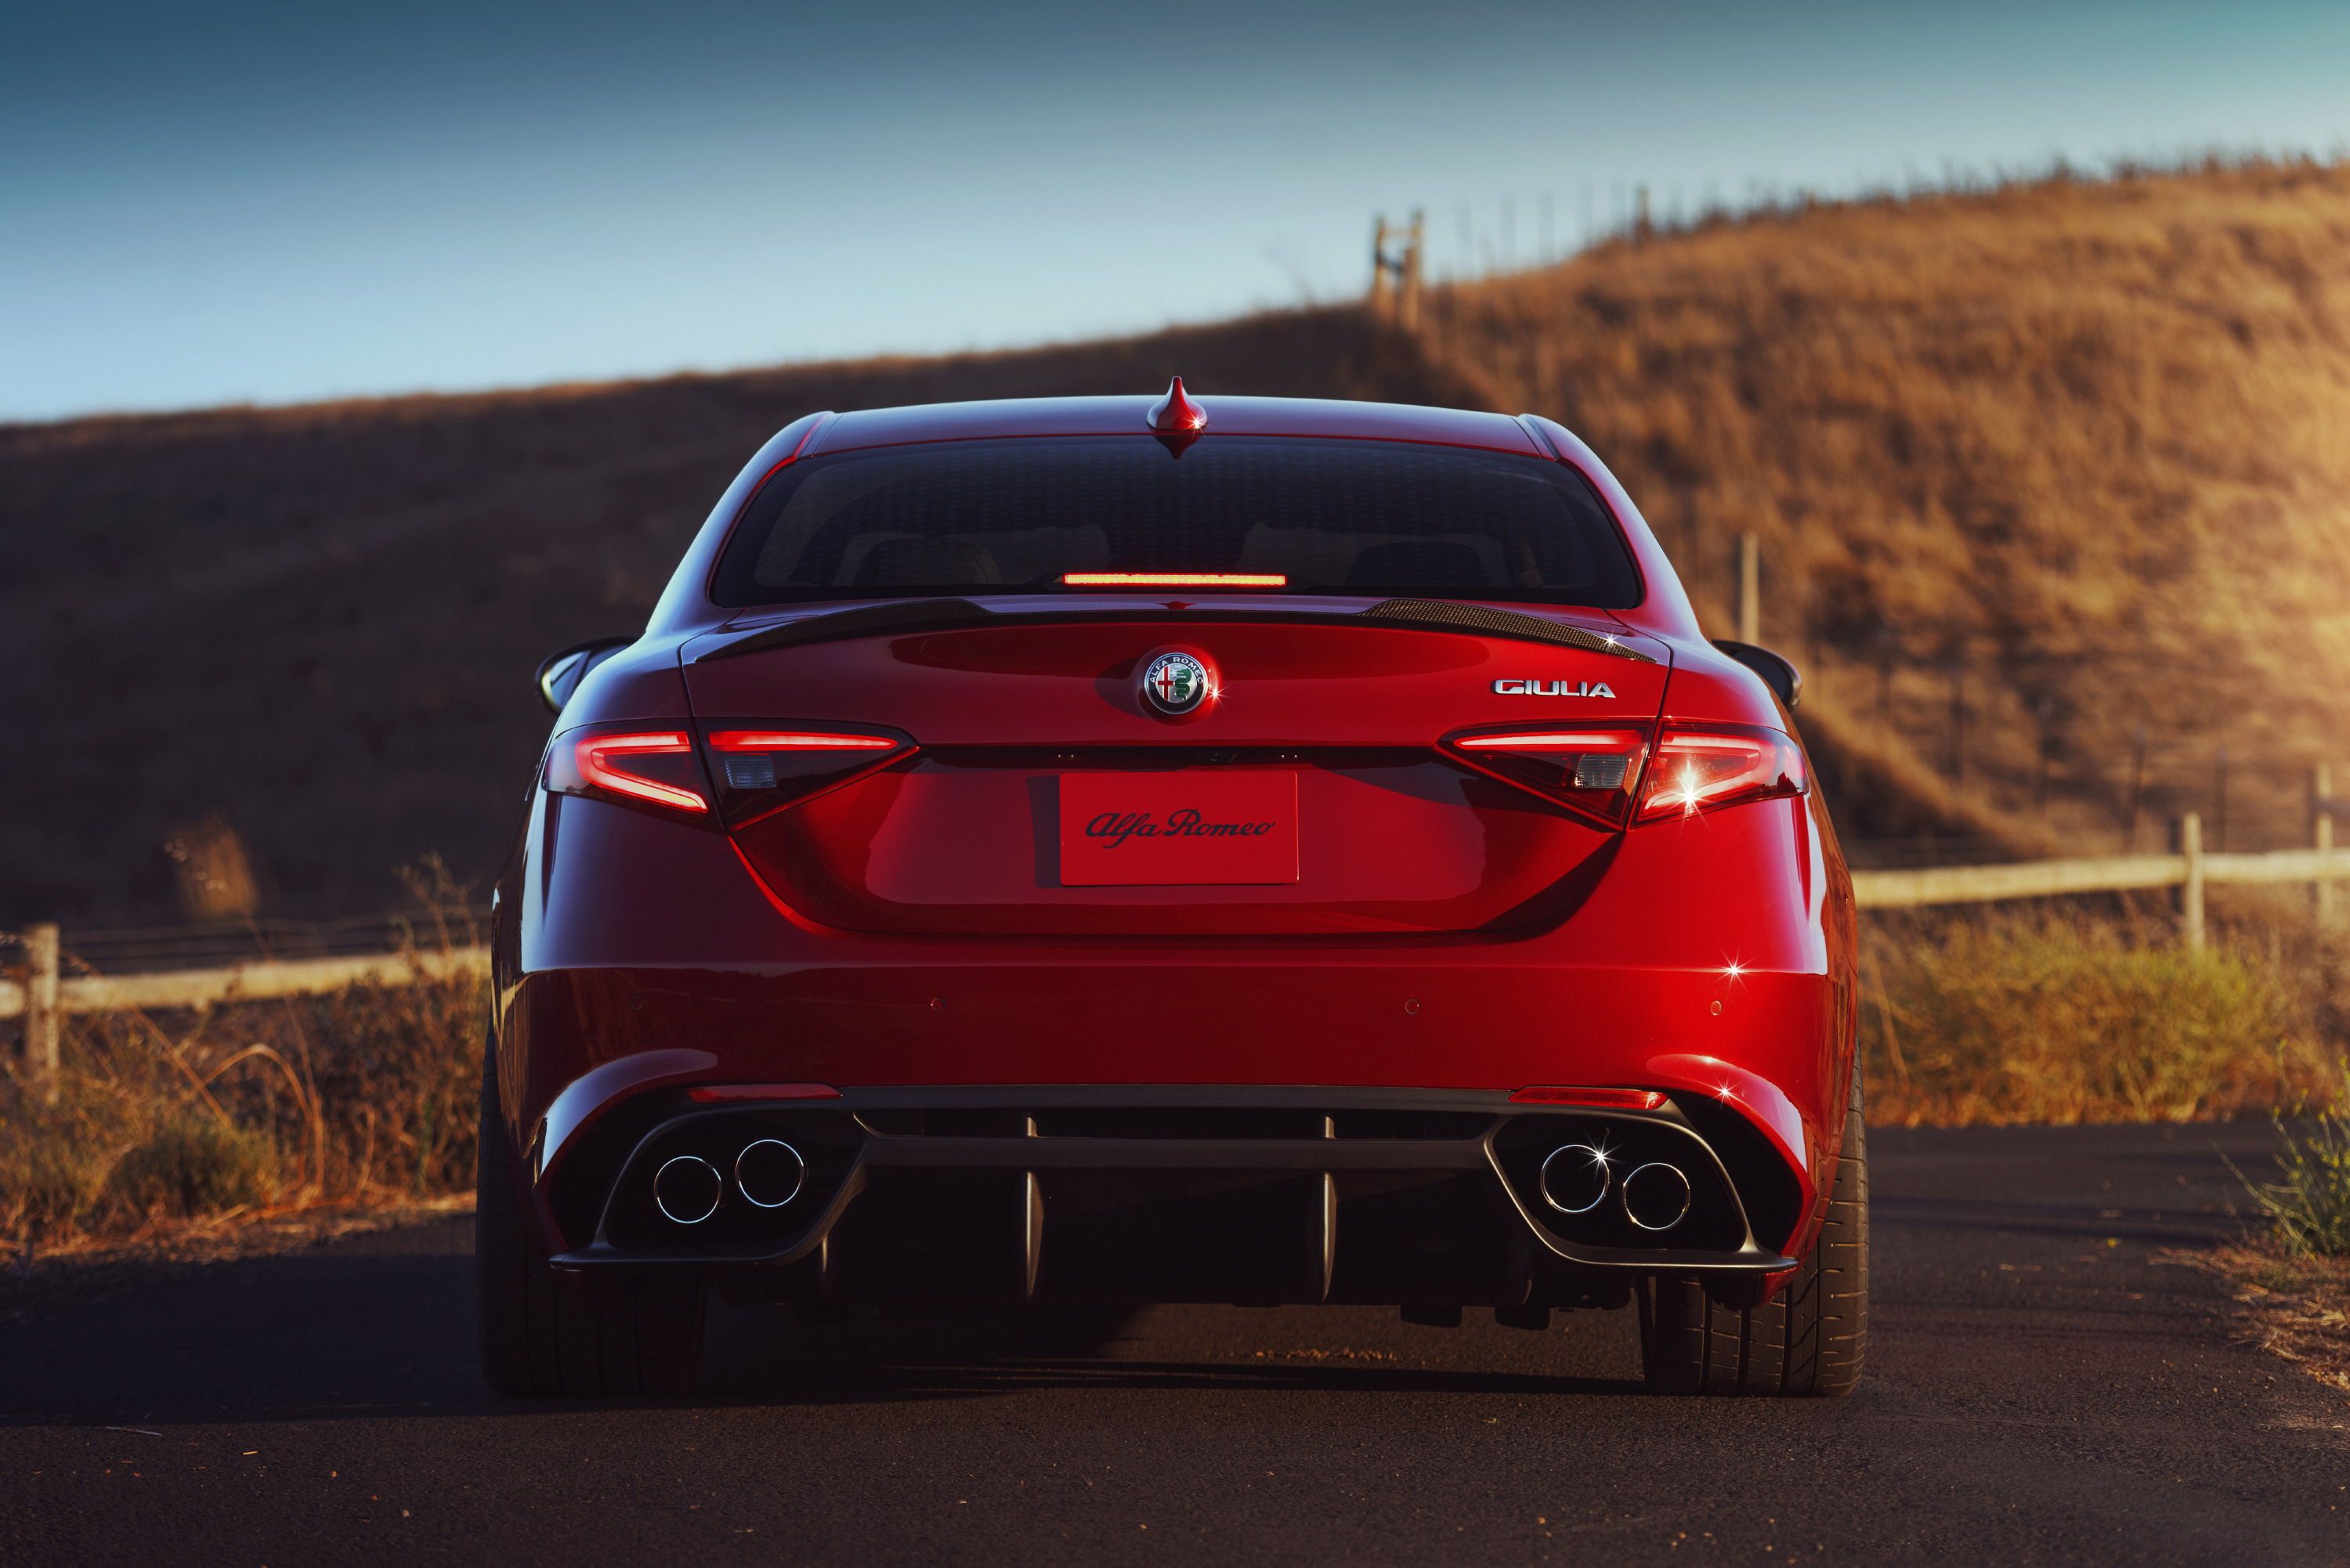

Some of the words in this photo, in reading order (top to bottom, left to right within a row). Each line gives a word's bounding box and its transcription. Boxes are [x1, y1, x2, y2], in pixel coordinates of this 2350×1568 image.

[1149, 659, 1169, 684] ALFA
[1173, 656, 1204, 684] ROMEO
[1495, 679, 1617, 699] GIULIA
[1085, 812, 1165, 849] Alfa
[1161, 809, 1276, 836] Romeo
